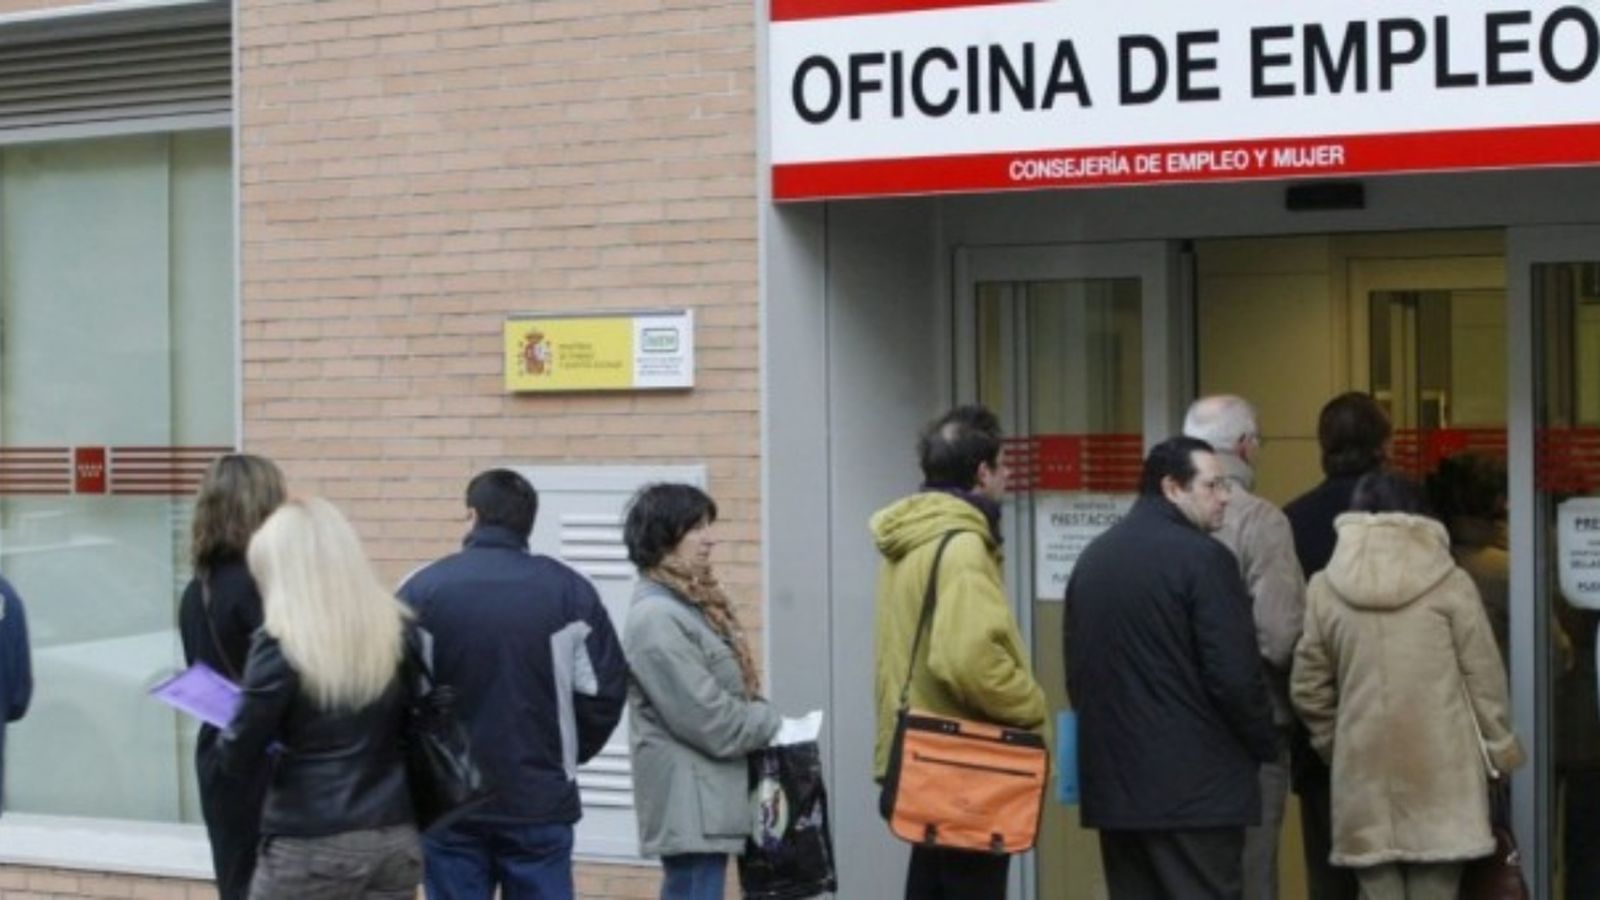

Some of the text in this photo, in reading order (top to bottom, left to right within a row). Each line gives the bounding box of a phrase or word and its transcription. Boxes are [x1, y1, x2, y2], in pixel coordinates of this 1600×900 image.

[791, 6, 1600, 124] OFICINA DE EMPLEO
[1009, 145, 1344, 181] CONSEJERÍA DE EMPLEO Y MUJER
